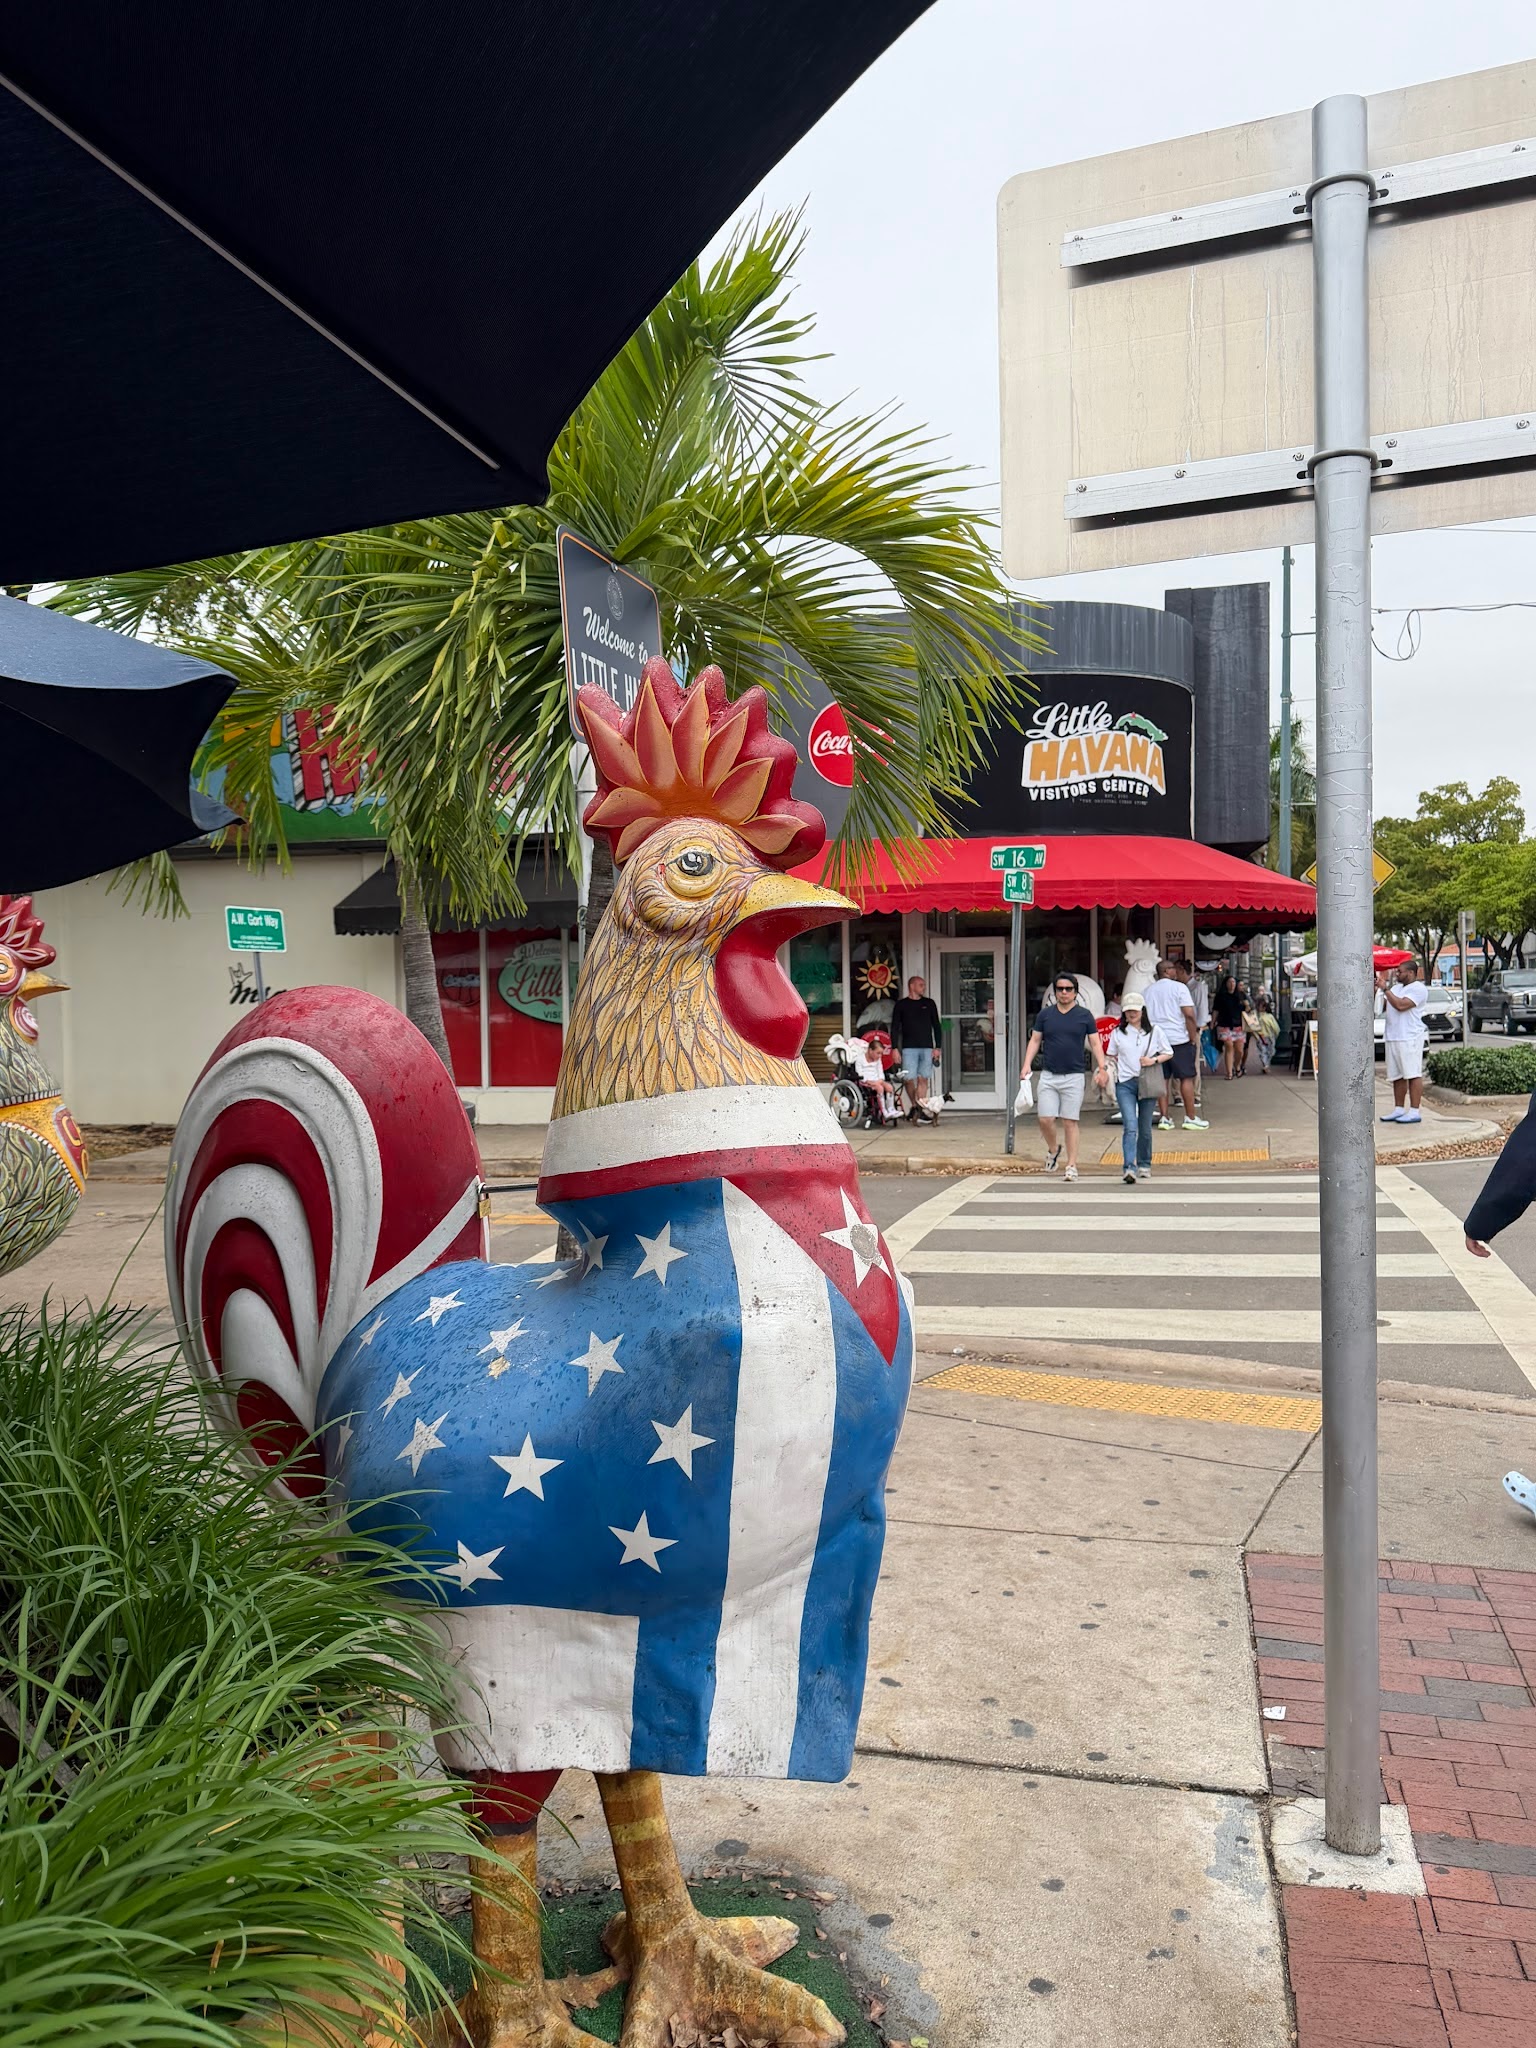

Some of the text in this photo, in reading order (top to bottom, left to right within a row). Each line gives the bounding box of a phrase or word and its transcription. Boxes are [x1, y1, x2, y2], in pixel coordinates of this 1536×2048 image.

[583, 606, 649, 665] Welcome to
[1025, 701, 1113, 739] Little
[1022, 731, 1166, 795] HAVANA
[1029, 779, 1150, 801] VISITORS CENTER
[992, 854, 1005, 867] SW
[1012, 850, 1026, 868] 16
[1007, 875, 1017, 888] SW
[1021, 873, 1027, 891] 8
[231, 912, 247, 925] A.W.
[263, 914, 279, 930] Way
[1165, 930, 1185, 939] SVG
